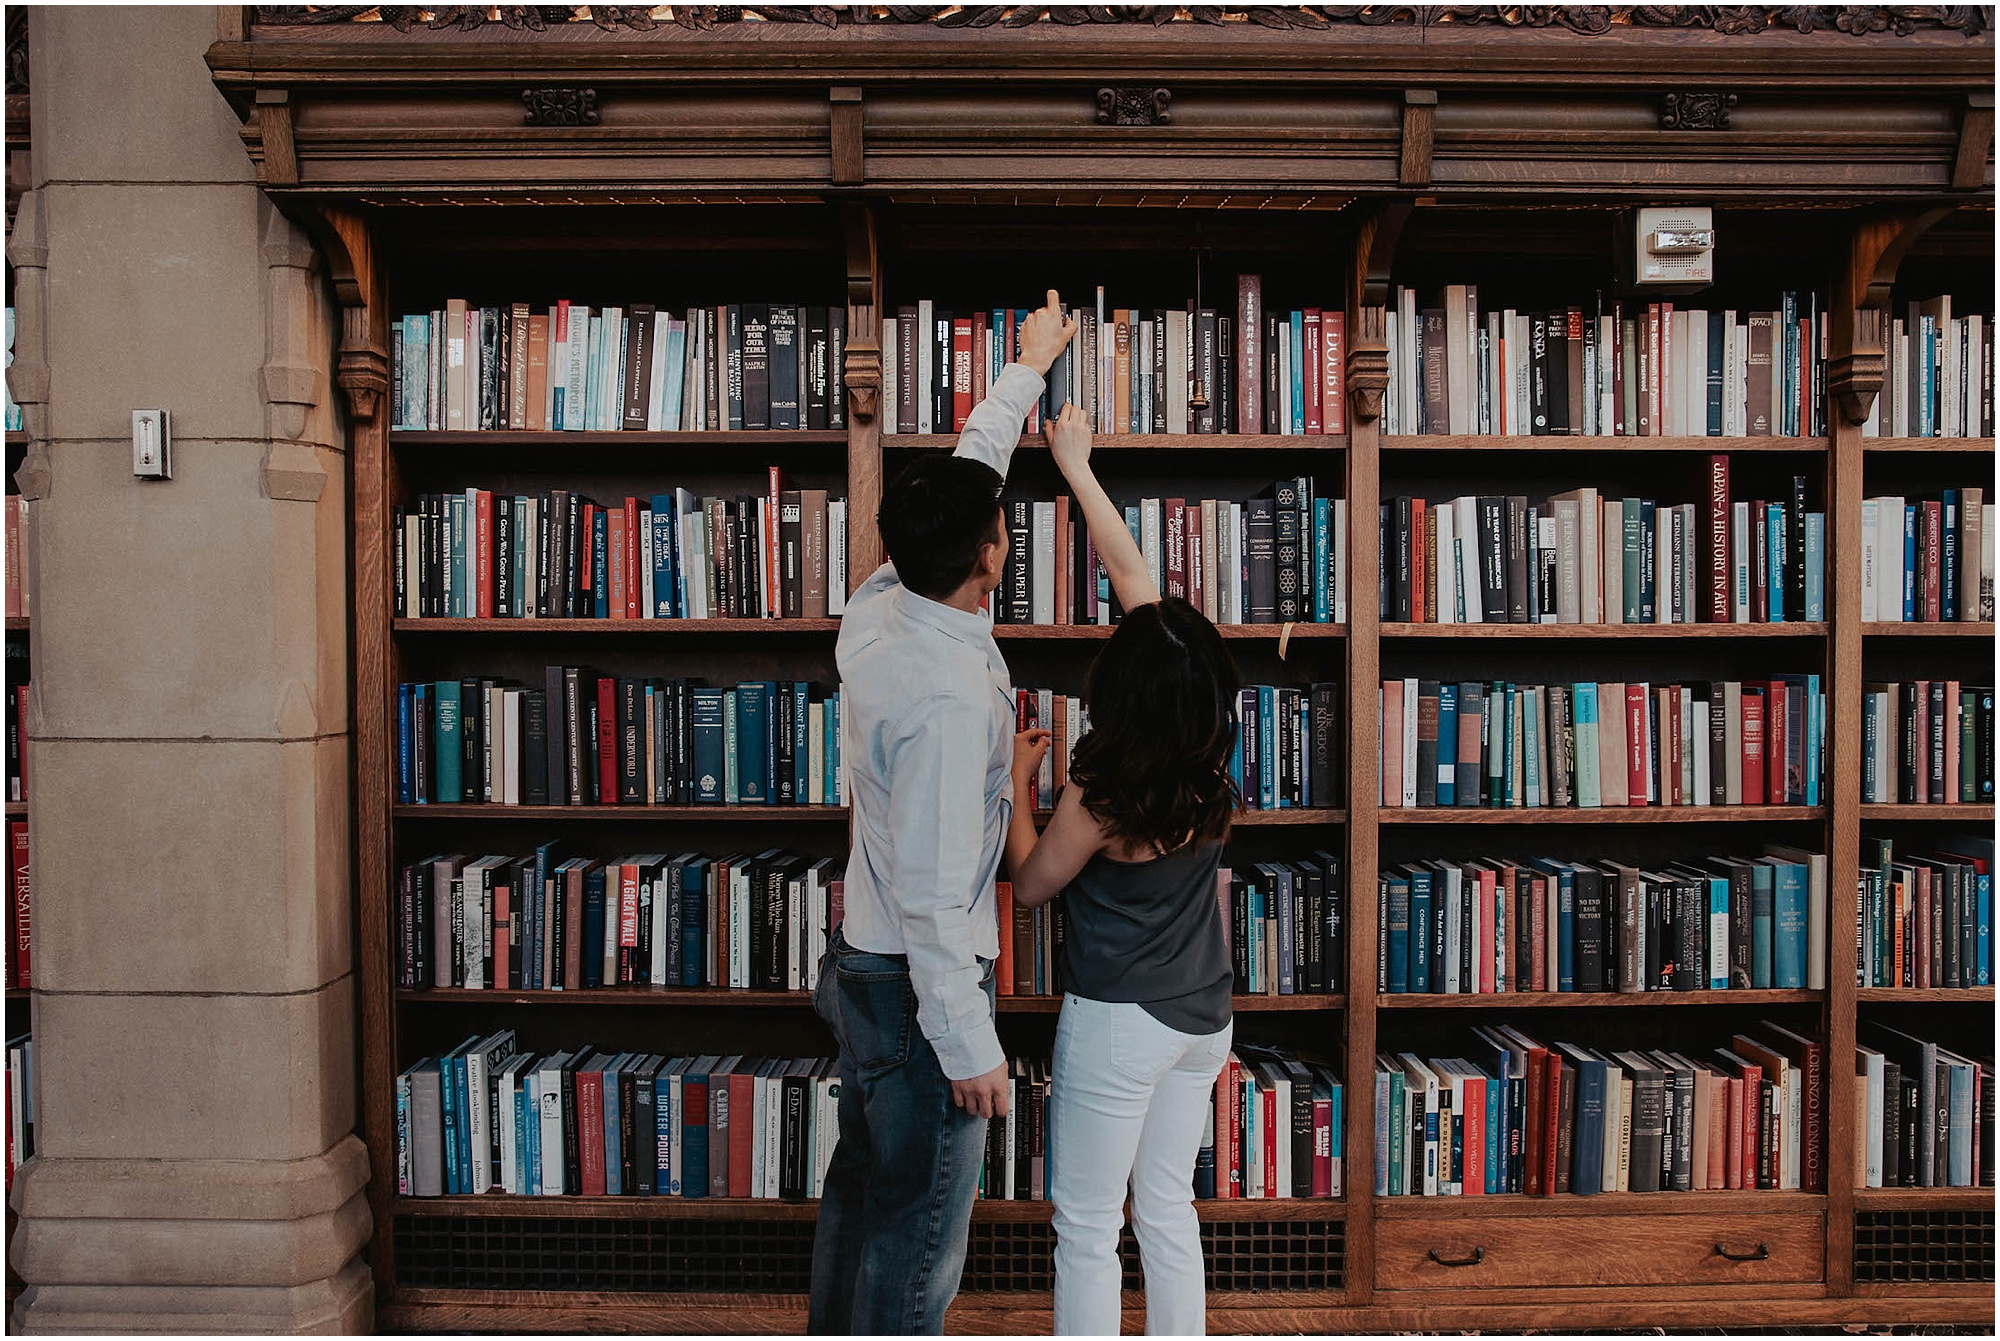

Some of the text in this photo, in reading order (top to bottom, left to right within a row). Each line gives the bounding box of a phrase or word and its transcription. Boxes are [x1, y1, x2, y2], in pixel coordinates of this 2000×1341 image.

[1686, 269, 1706, 277] FIRE
[1535, 320, 1545, 359] FONDA
[569, 315, 582, 414] NATURE'S METROPOLIS
[817, 340, 825, 396] Mountain Fires
[1326, 332, 1340, 396] DOUBT
[1429, 346, 1442, 403] MOUNTBATTEN
[656, 528, 662, 537] OF
[1167, 518, 1175, 570] Correspondence
[1174, 519, 1183, 572] Berg-Schoenberg
[1714, 521, 1725, 572] HISTORY
[1799, 539, 1804, 552] IN
[1946, 534, 1954, 556] CITIES
[613, 542, 622, 568] Prophet
[1016, 535, 1026, 598] THE PAPER
[1714, 576, 1725, 590] IN
[1714, 592, 1725, 615] ART
[627, 726, 635, 777] UNDERWORLD
[1317, 707, 1326, 765] KINGDOM
[17, 865, 30, 952] VERSAILLES
[623, 887, 635, 916] GREAT
[641, 884, 650, 907] CIA
[622, 918, 634, 943] WALL
[717, 1089, 728, 1130] CHINA
[791, 1087, 799, 1116] D-DAY
[1808, 1048, 1820, 1168] LORENZO MONACO
[658, 1095, 668, 1169] WATER POWER
[1511, 1129, 1519, 1155] CHAOS
[1682, 1108, 1691, 1144] Washington
[1663, 1135, 1673, 1171] ETHNOGRAPHY
